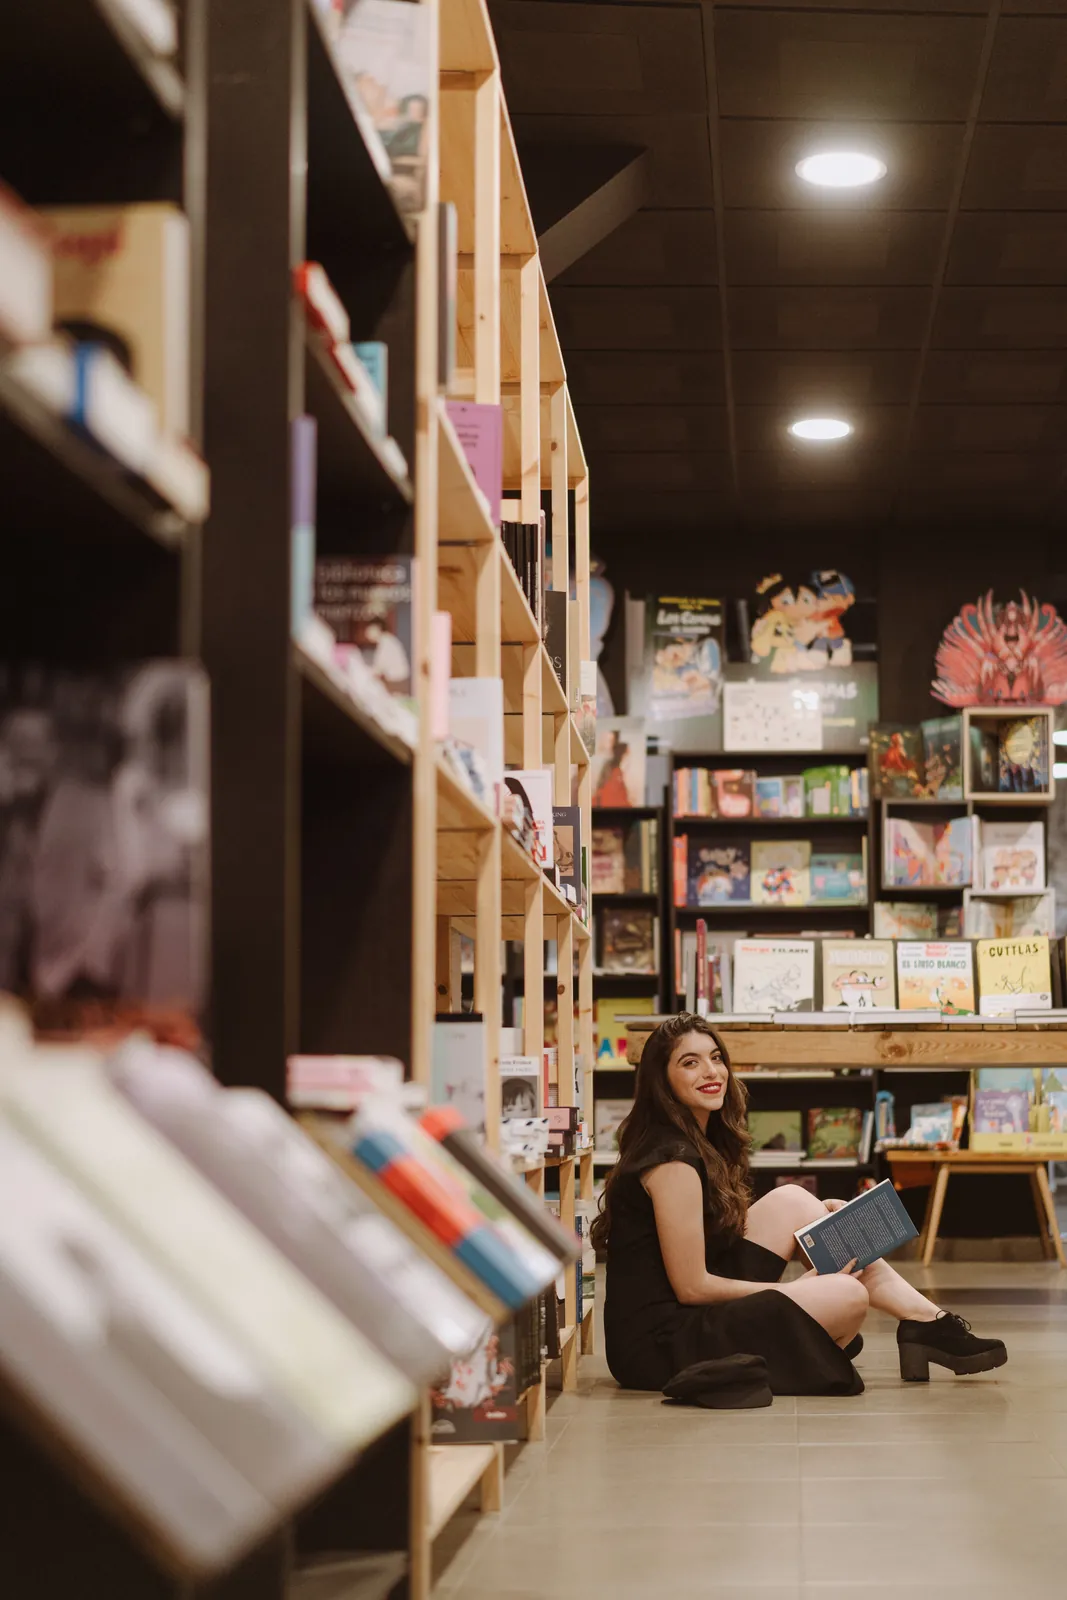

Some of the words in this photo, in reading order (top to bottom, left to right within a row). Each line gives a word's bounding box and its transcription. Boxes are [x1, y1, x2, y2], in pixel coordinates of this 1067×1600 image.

[989, 943, 1040, 957] CUTTLAS
[902, 960, 911, 969] EL
[937, 960, 967, 969] BLANCO
